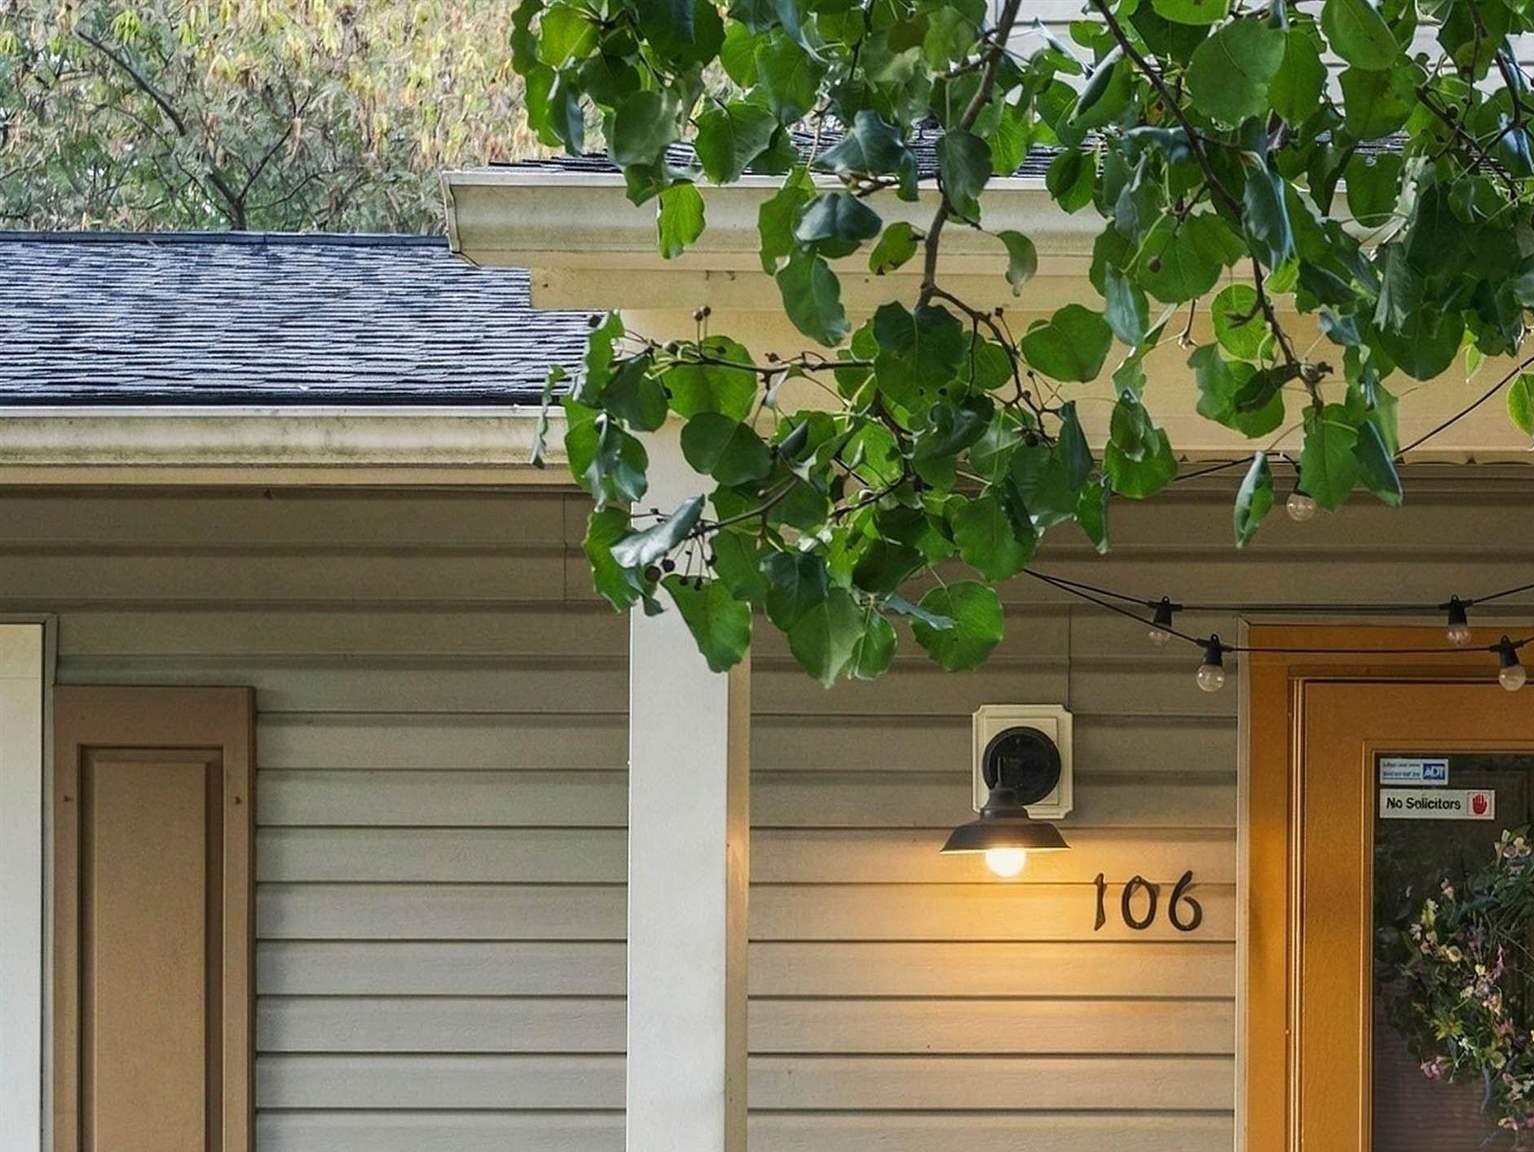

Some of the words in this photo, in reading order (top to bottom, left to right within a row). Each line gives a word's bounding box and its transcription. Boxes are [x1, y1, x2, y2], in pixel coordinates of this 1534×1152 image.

[1386, 797, 1403, 810] No
[1406, 797, 1462, 810] Solicitors
[1094, 870, 1202, 932] 106
